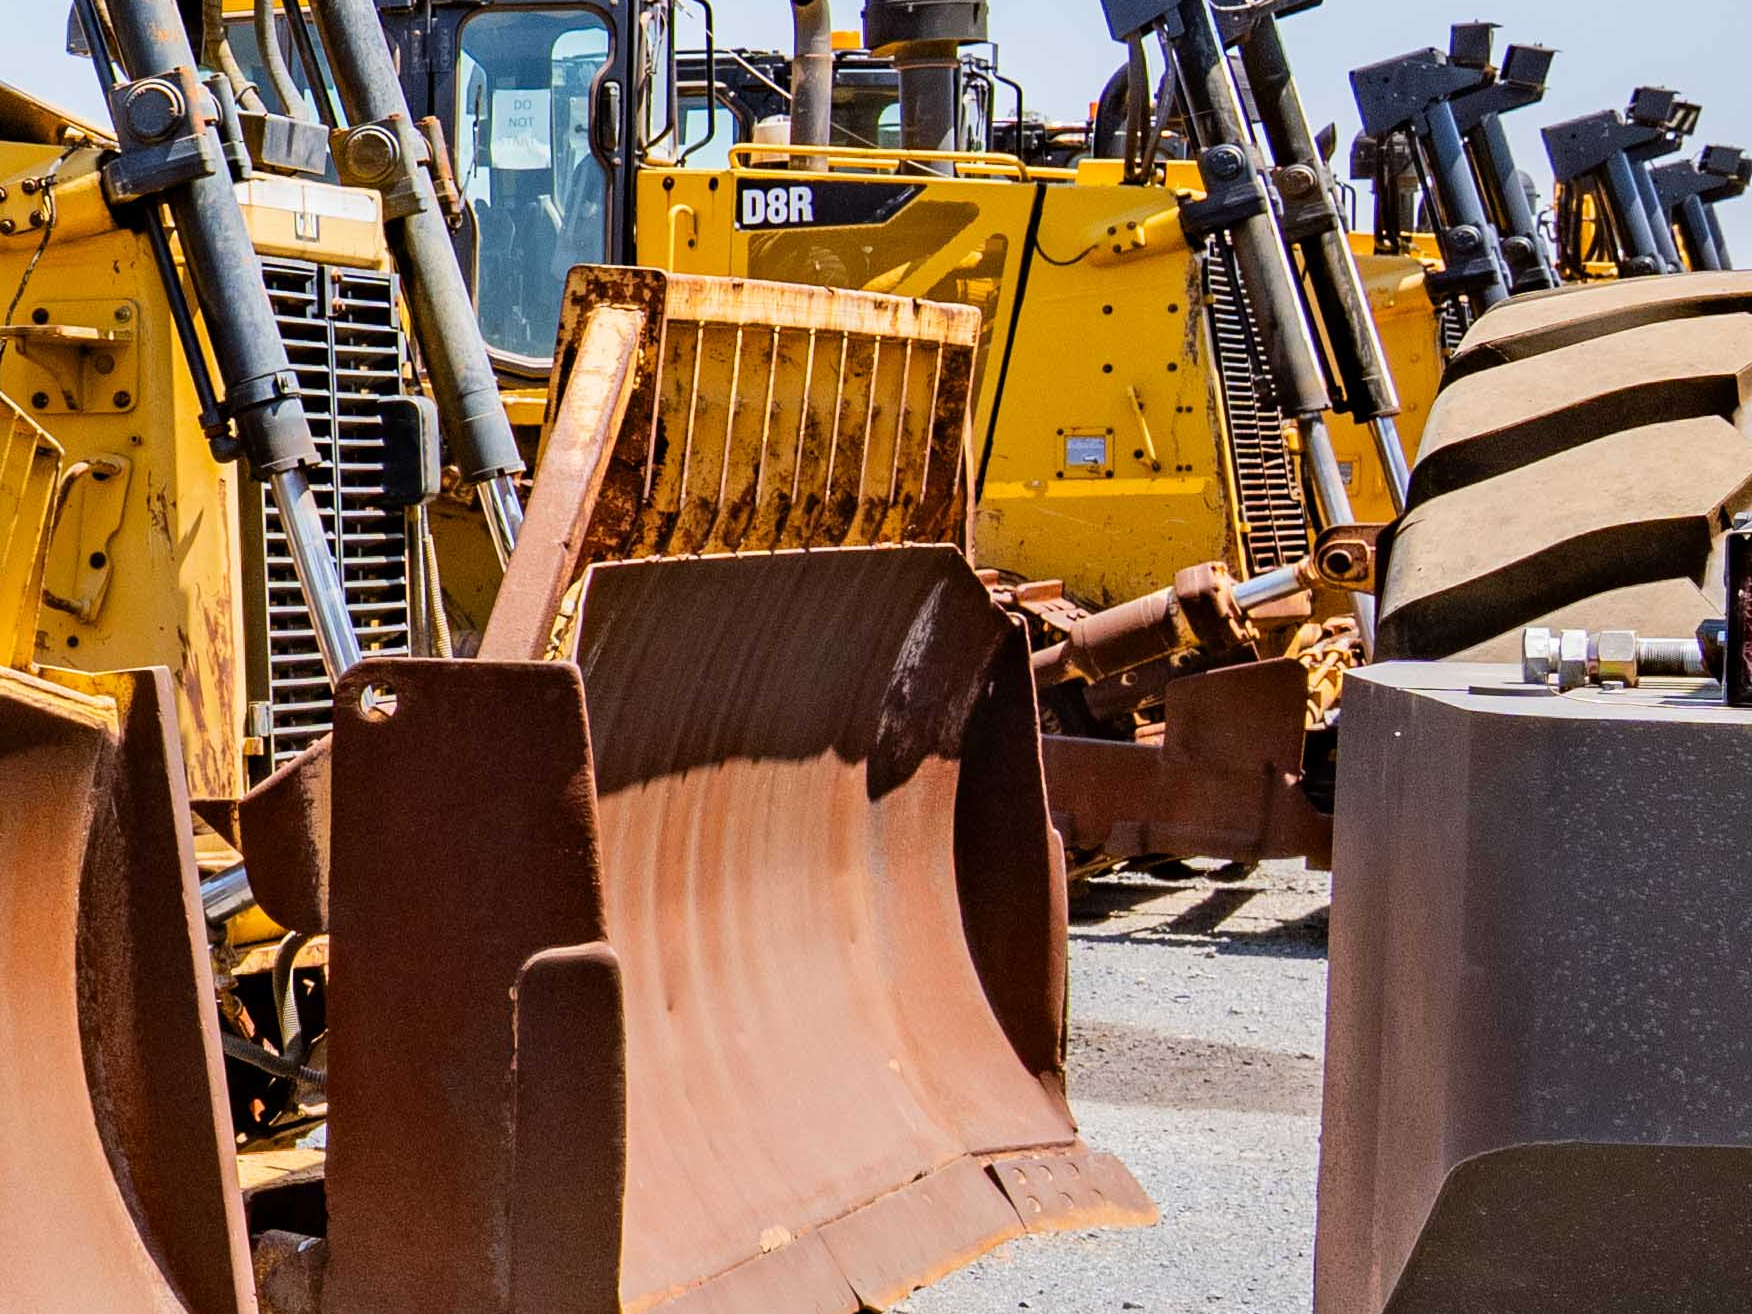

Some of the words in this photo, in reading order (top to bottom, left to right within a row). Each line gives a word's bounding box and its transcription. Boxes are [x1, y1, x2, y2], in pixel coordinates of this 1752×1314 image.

[514, 99, 532, 110] DO
[508, 116, 536, 127] NOT
[742, 186, 814, 225] D8R
